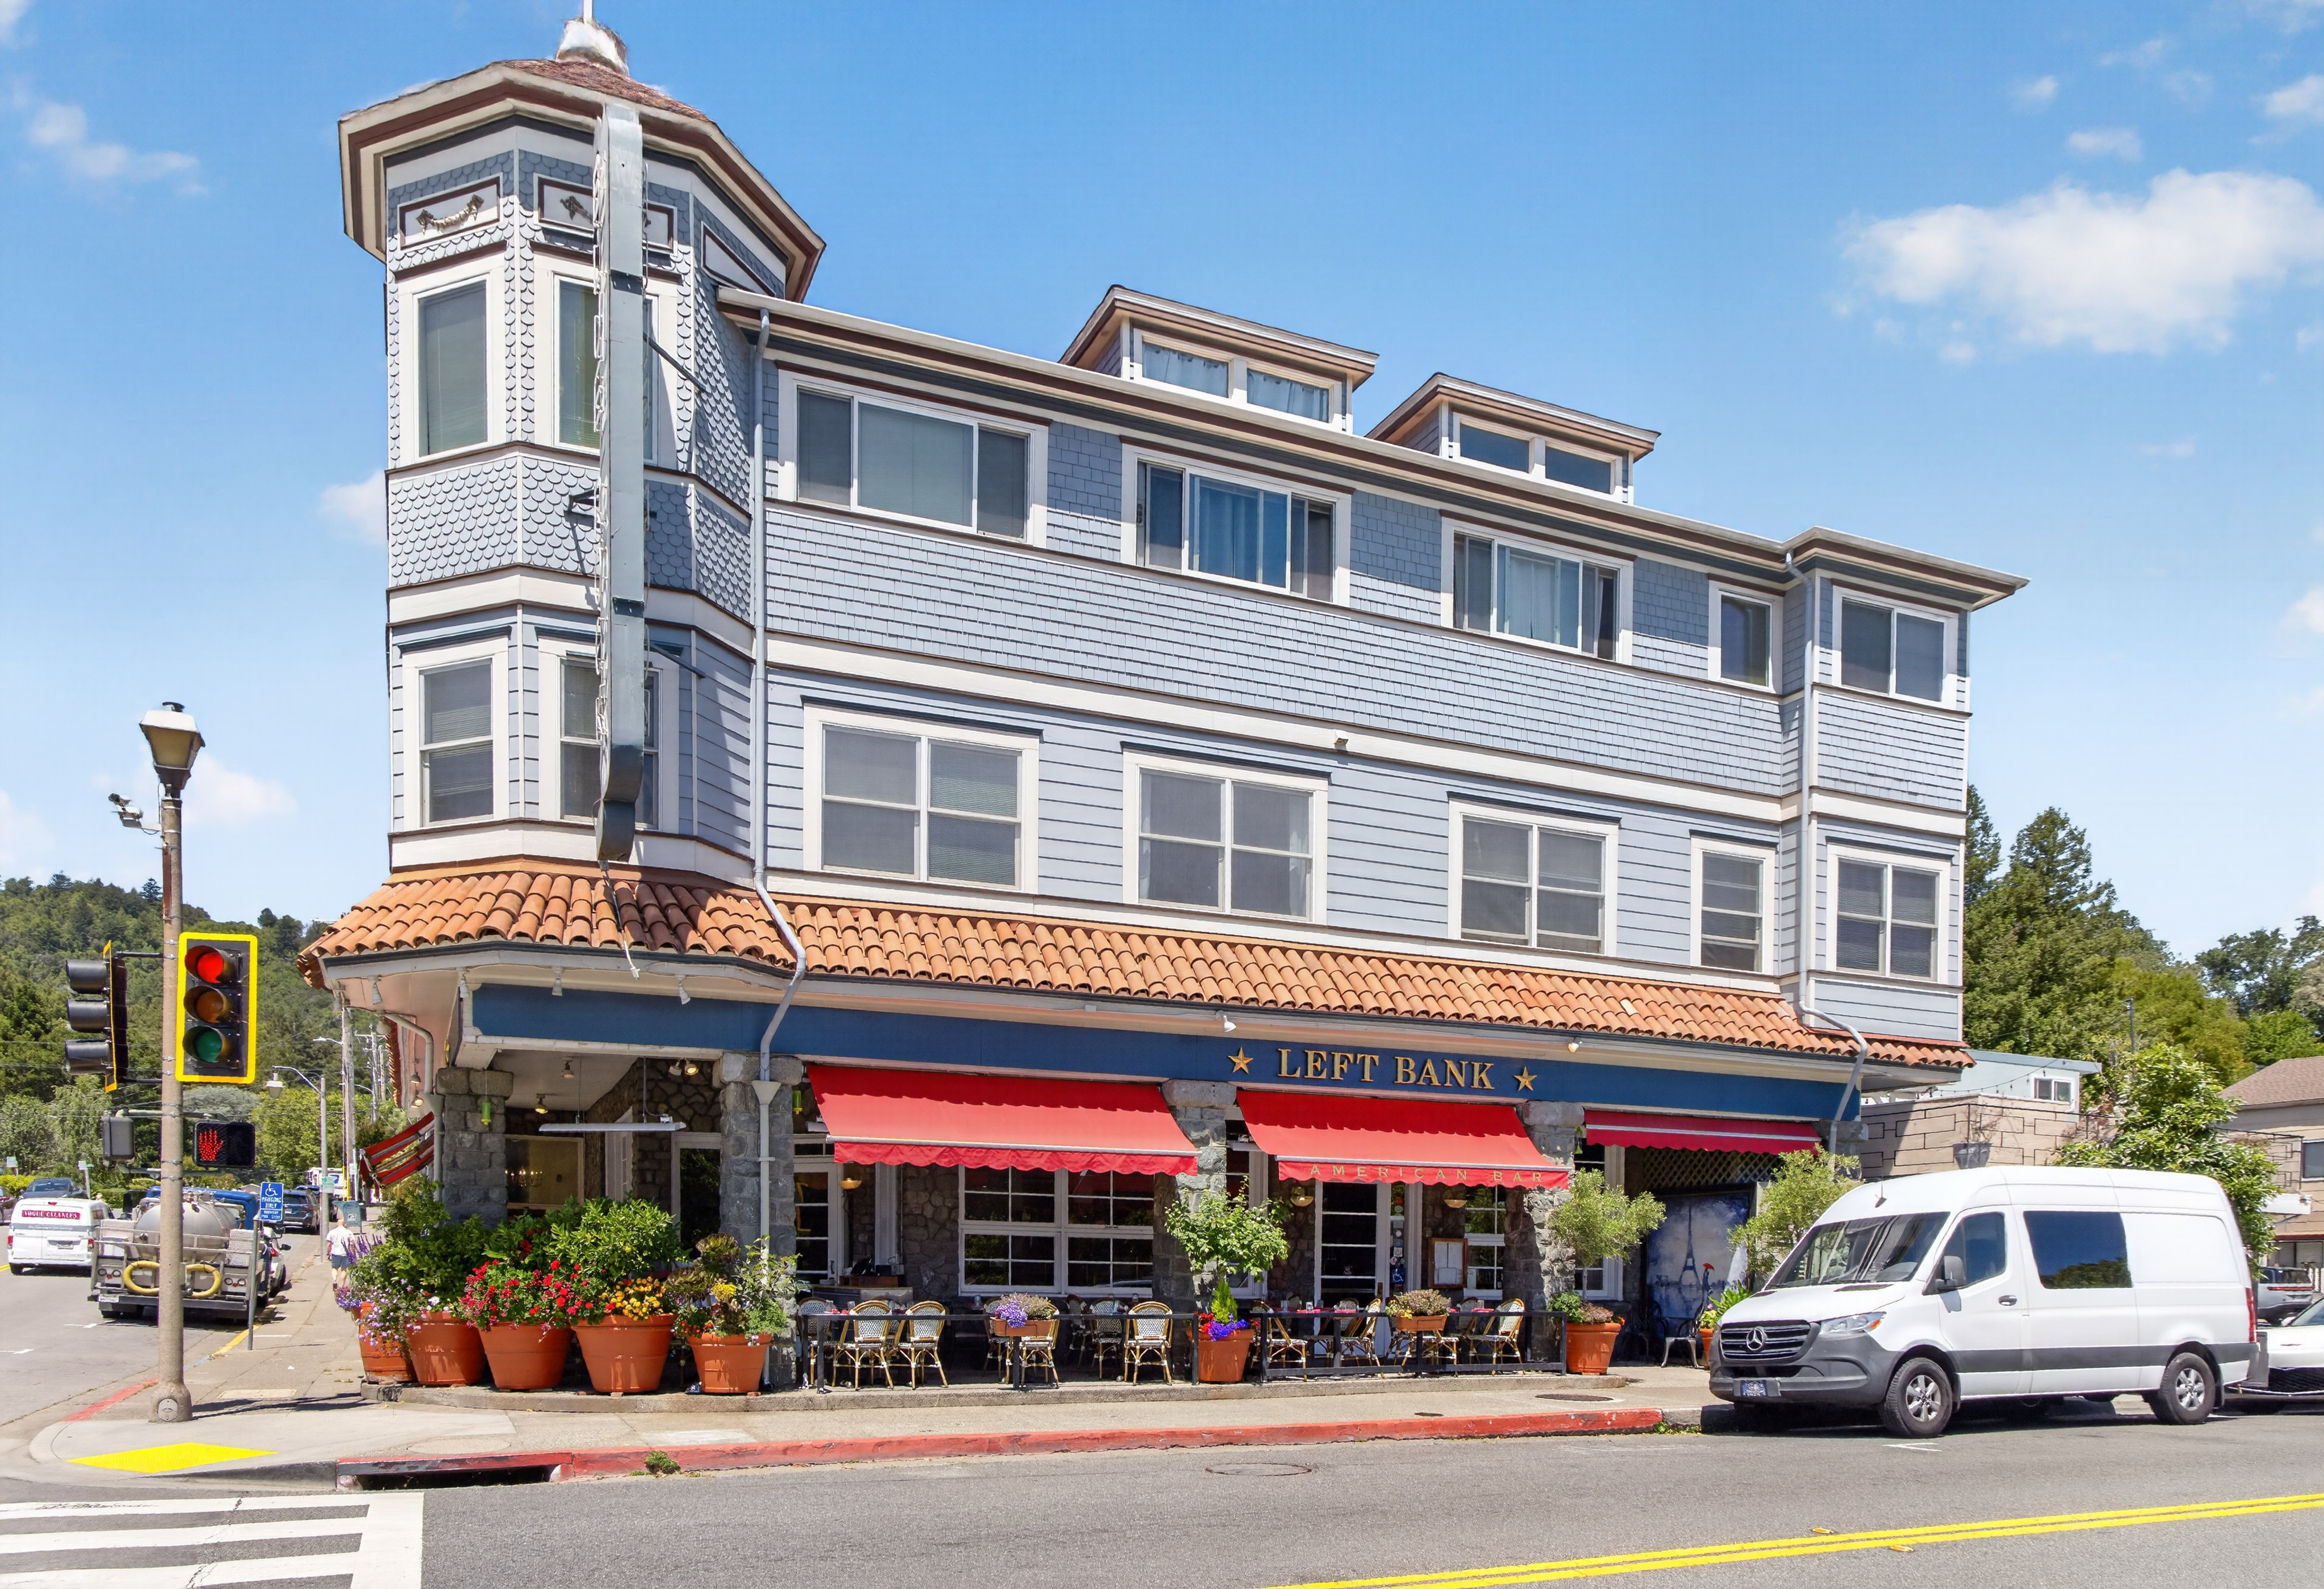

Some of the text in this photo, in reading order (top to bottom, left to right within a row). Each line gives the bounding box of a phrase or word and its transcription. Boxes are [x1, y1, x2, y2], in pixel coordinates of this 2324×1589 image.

[1278, 1048, 1495, 1089] LEFT BANK
[1310, 1164, 1542, 1182] AMERICAN BAR
